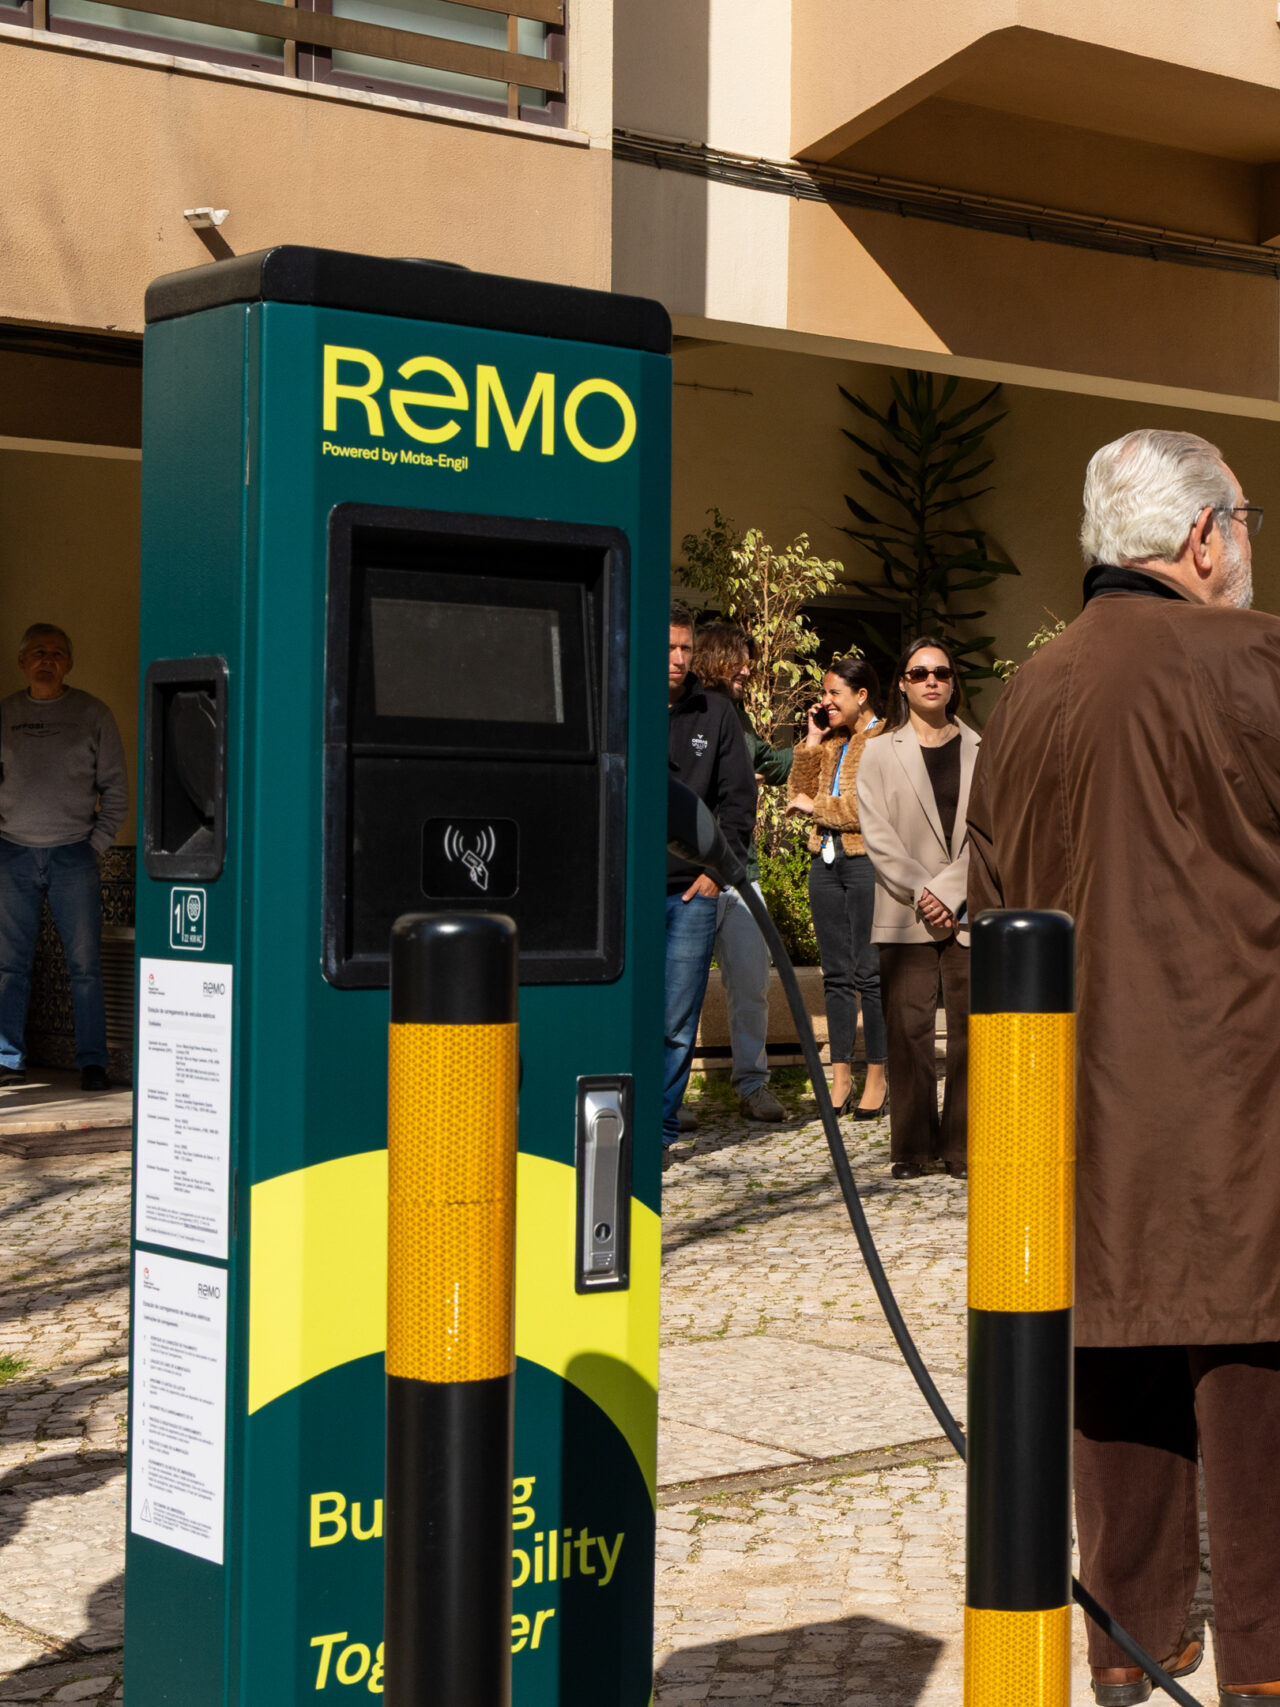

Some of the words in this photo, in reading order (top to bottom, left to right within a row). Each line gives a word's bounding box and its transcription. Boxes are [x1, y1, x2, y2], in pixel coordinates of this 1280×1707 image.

[322, 441, 379, 461] Powered
[381, 447, 398, 465] by
[400, 450, 469, 472] Mota-Engil
[174, 903, 181, 934] 1
